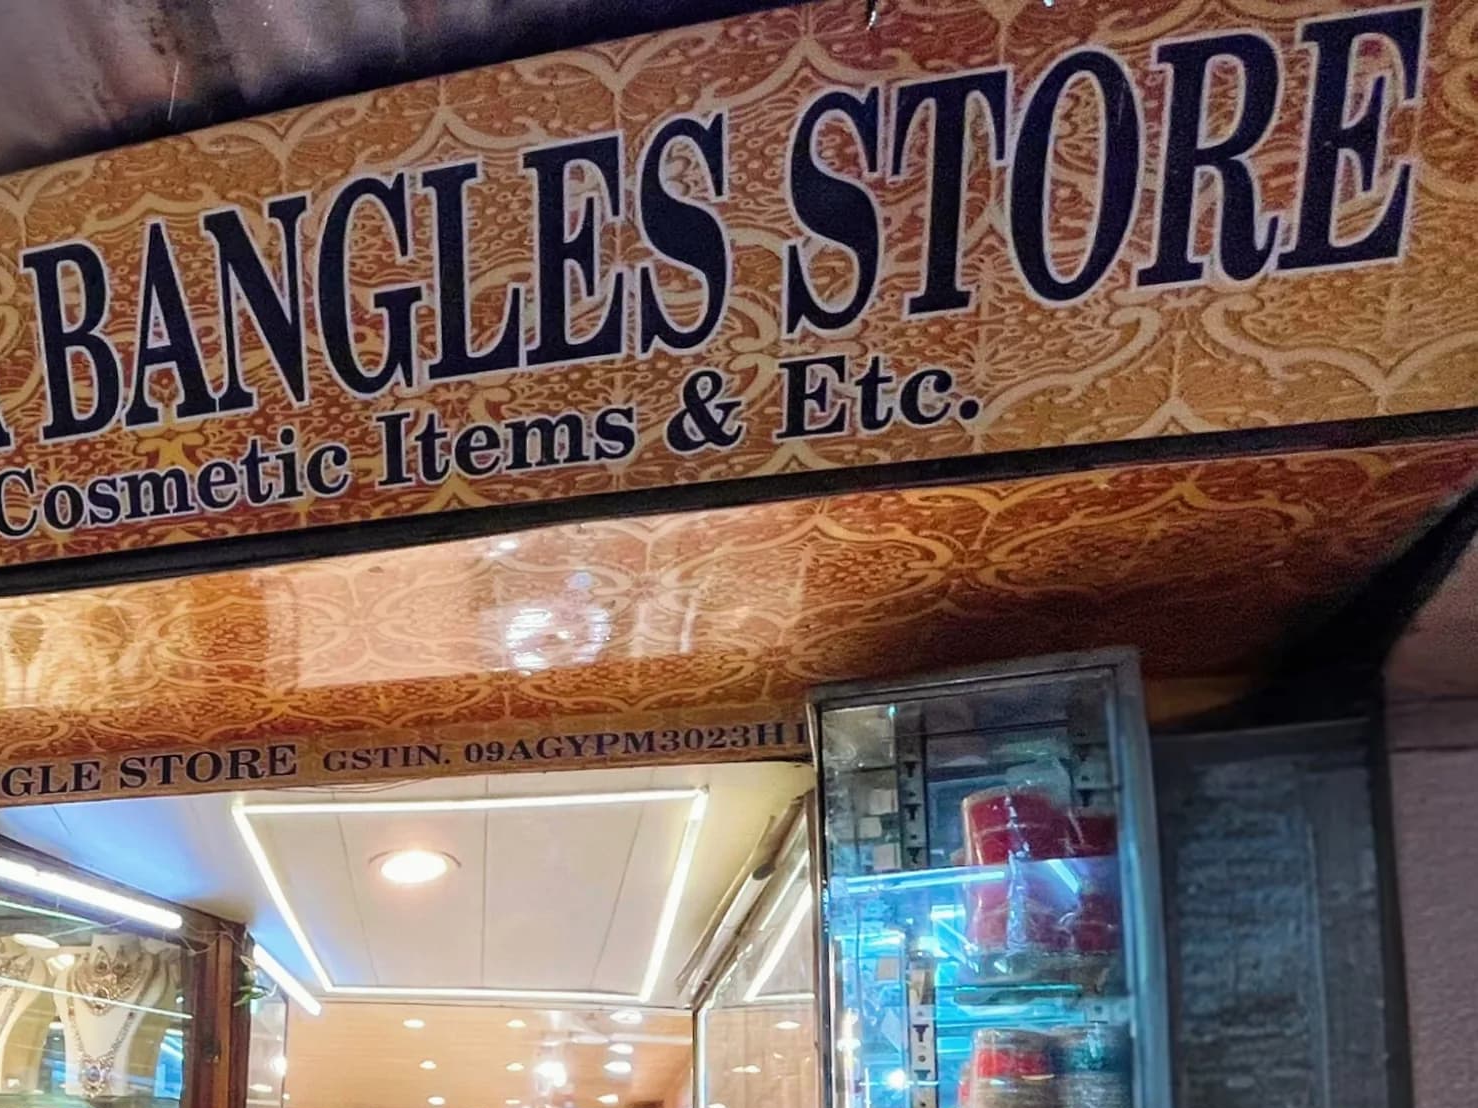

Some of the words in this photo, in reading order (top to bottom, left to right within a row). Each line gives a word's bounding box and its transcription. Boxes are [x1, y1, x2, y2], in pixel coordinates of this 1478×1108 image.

[23, 113, 723, 441] BANGLES
[788, 7, 1429, 332] STORE
[376, 400, 636, 486] Items
[668, 367, 741, 453] &
[777, 354, 982, 441] Etc.
[119, 744, 298, 789] STORE
[322, 744, 451, 773] GSTIN.
[464, 722, 807, 765] 09AGYPM3023H1
